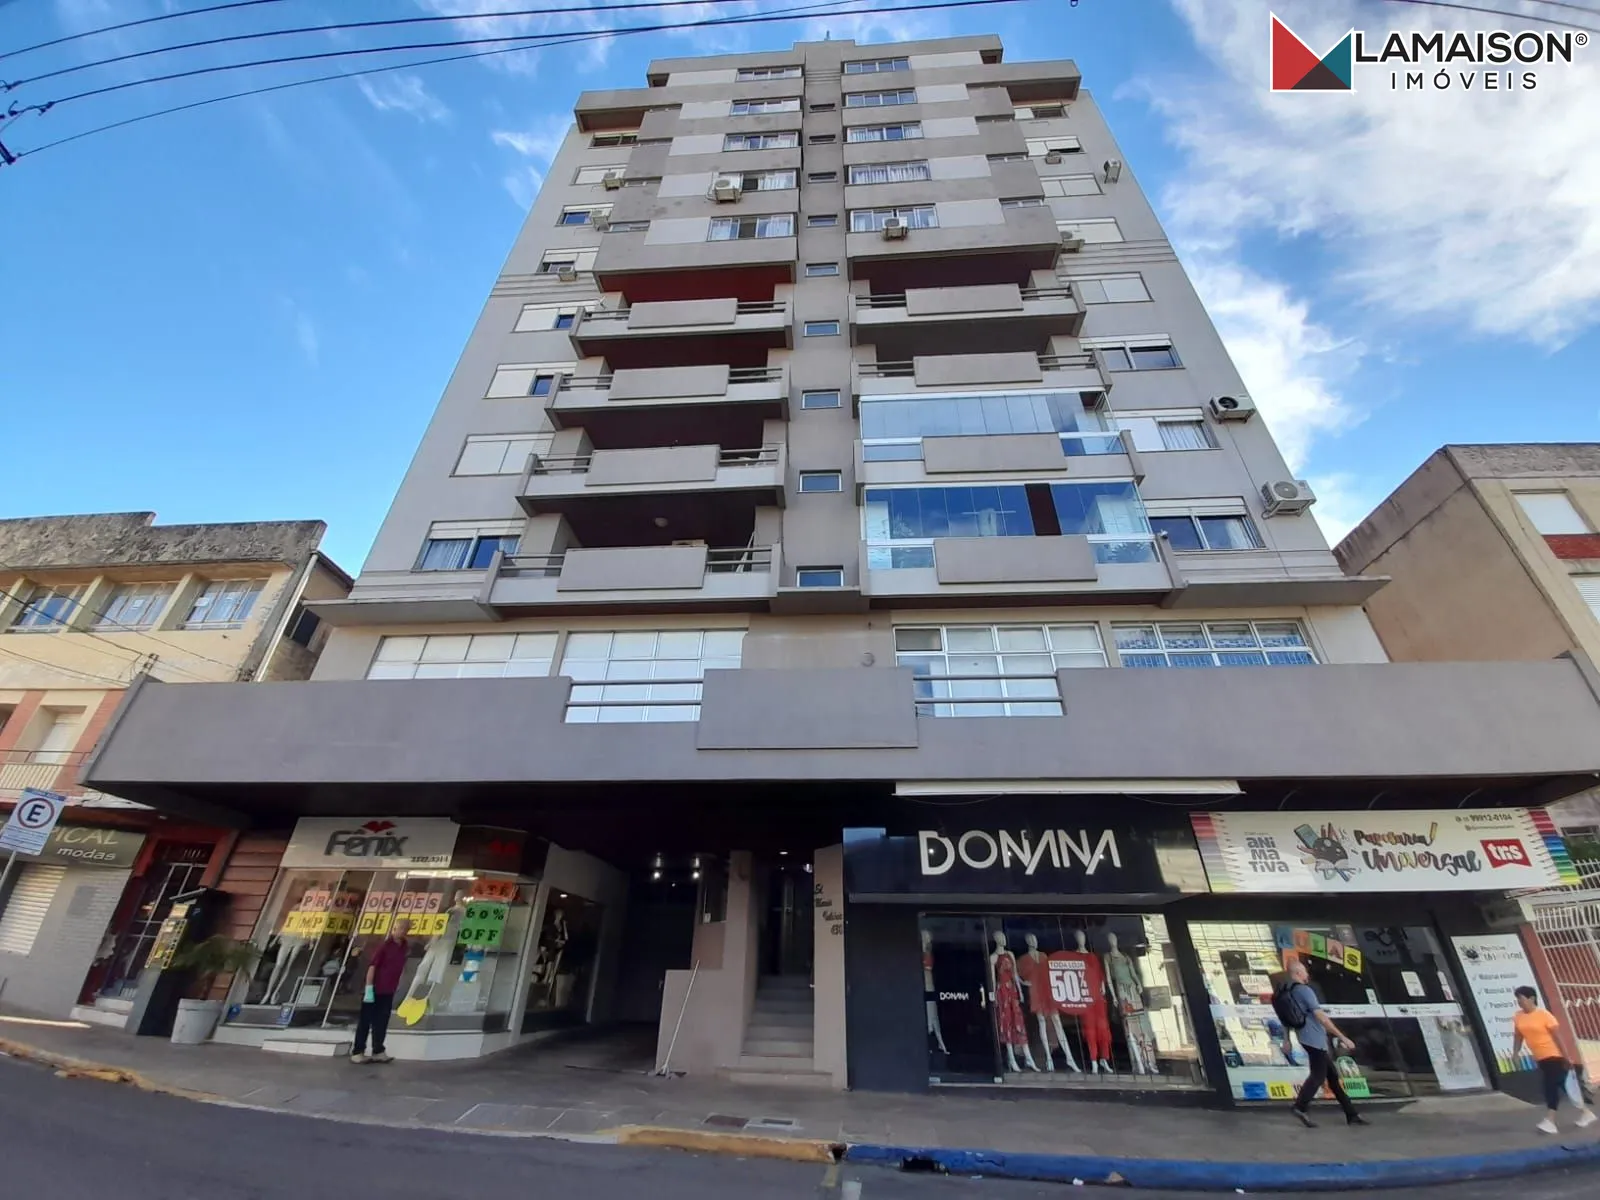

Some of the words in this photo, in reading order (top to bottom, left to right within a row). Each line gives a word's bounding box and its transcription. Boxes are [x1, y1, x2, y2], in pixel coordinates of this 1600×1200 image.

[27, 804, 45, 822] E
[57, 847, 116, 861] modas
[918, 829, 1121, 875] DONANA
[1362, 848, 1481, 876] Universal
[465, 907, 505, 921] 60%
[460, 928, 498, 942] OFF
[939, 992, 969, 1000] DONANA
[1271, 1085, 1287, 1097] ATÉ
